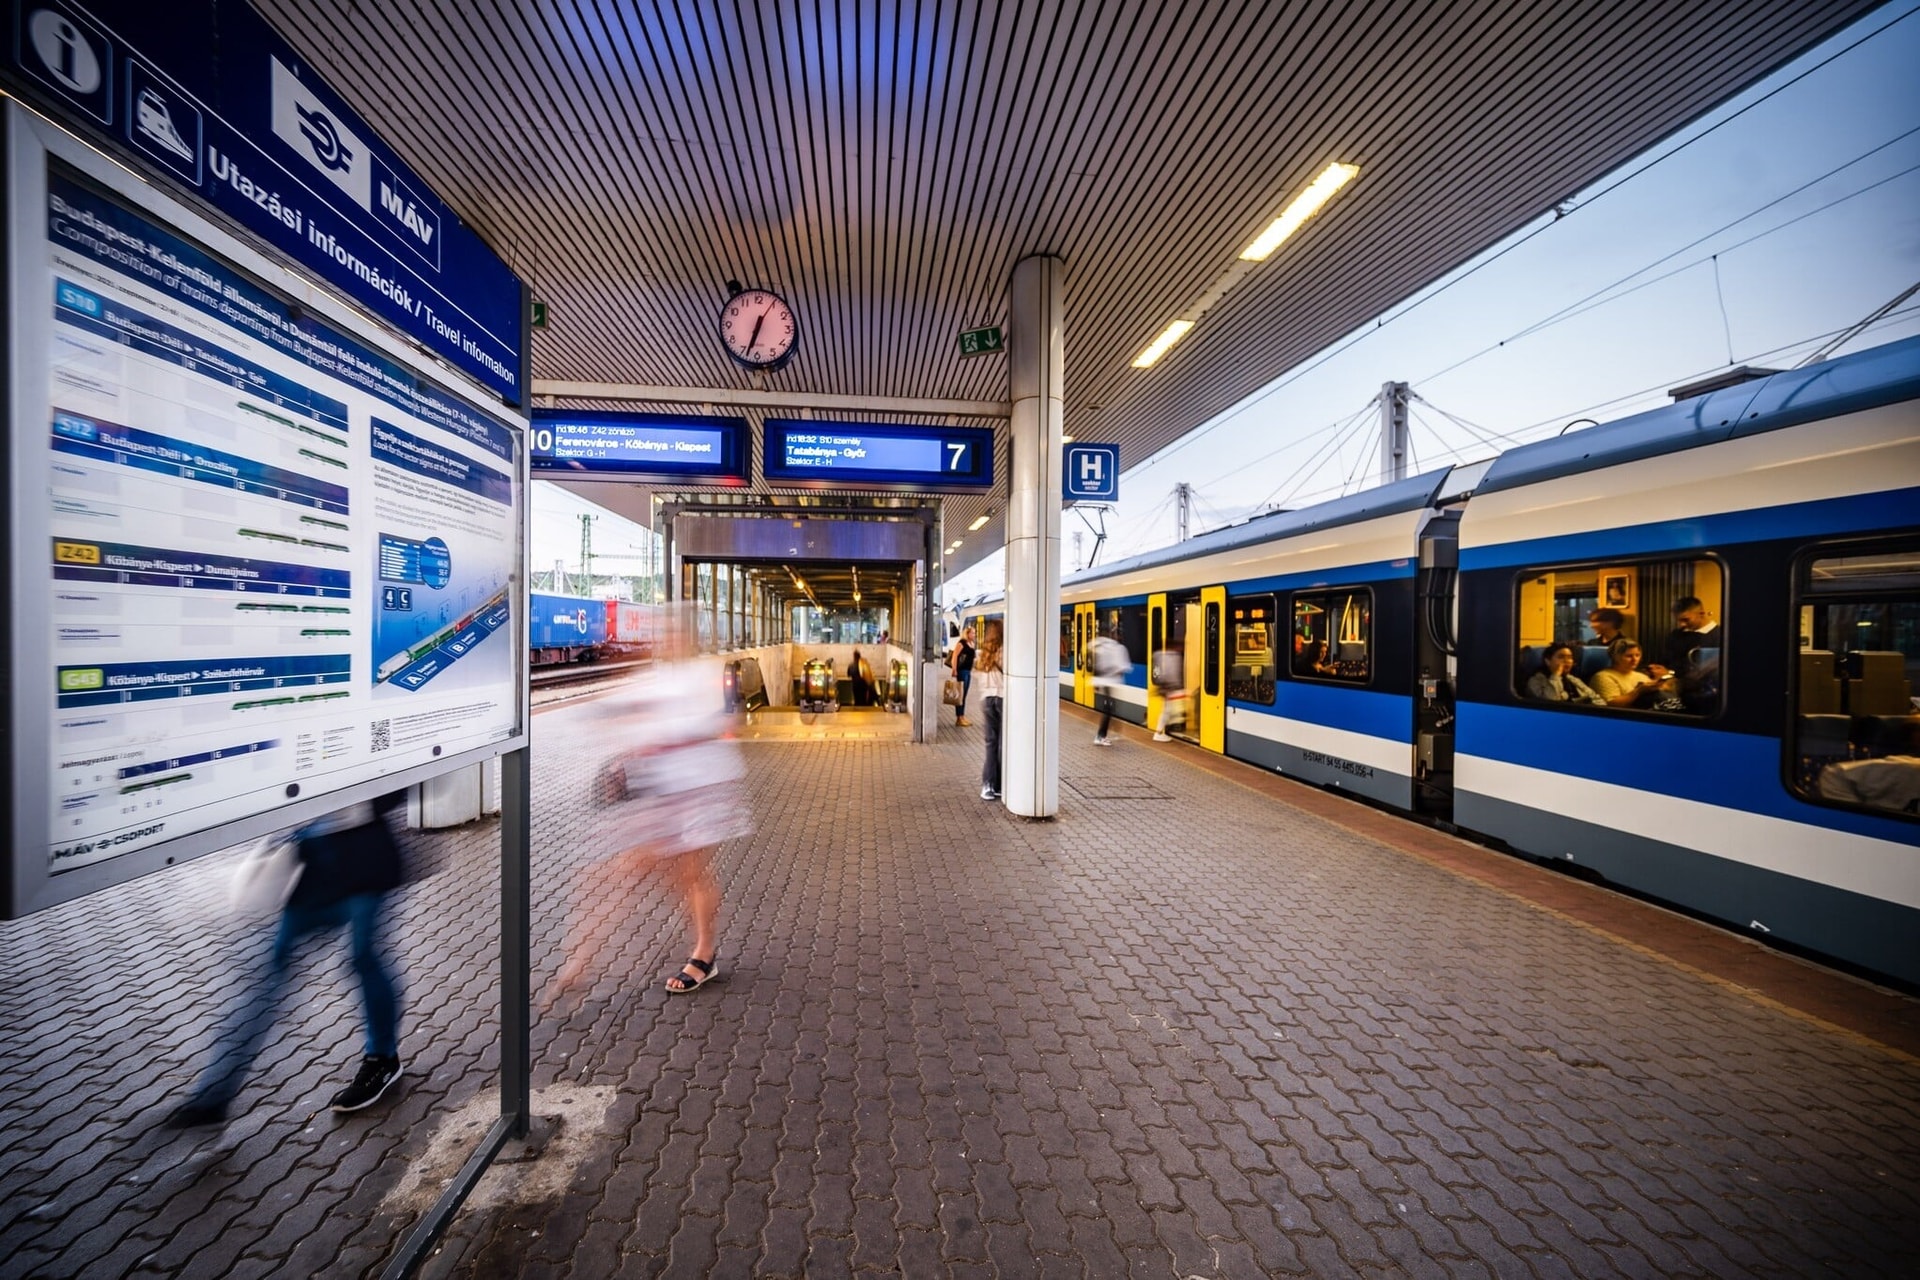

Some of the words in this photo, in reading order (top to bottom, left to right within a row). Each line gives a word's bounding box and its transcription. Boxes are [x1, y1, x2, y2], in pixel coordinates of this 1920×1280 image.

[380, 180, 434, 245] MÁV
[208, 145, 302, 235] Utazási
[308, 219, 413, 313] információk
[424, 306, 460, 346] Travel
[463, 335, 514, 385] information
[50, 193, 221, 293] Budapest-Kelenföld
[223, 285, 281, 327] állomásról
[289, 322, 336, 357] Dunántúl
[51, 217, 162, 281] Composition
[163, 274, 181, 289] of
[181, 281, 218, 309] trains
[218, 300, 270, 339] departing
[270, 327, 293, 346] from
[741, 299, 749, 307] 11
[754, 296, 763, 304] 12
[731, 307, 739, 316] 10
[780, 311, 787, 320] 2
[725, 321, 732, 329] 9
[785, 325, 791, 334] 3
[729, 335, 736, 344] 8
[740, 346, 747, 354] 7
[754, 351, 760, 360] 6
[770, 348, 776, 357] 5
[625, 438, 668, 451] Kőbánya
[786, 446, 837, 458] Tatabánya
[843, 448, 866, 459] Győr
[947, 443, 966, 470] 7
[826, 458, 832, 466] H
[1081, 454, 1102, 480] H
[62, 545, 95, 561] Z42
[104, 554, 192, 572] Kőbánya-Kispest
[401, 591, 408, 604] C
[1210, 616, 1217, 631] 2
[452, 643, 464, 652] B
[106, 672, 191, 686] Kőbánya-Kispest
[407, 676, 422, 685] A
[53, 842, 95, 859] MÁV
[114, 823, 165, 845] CSOPORT
